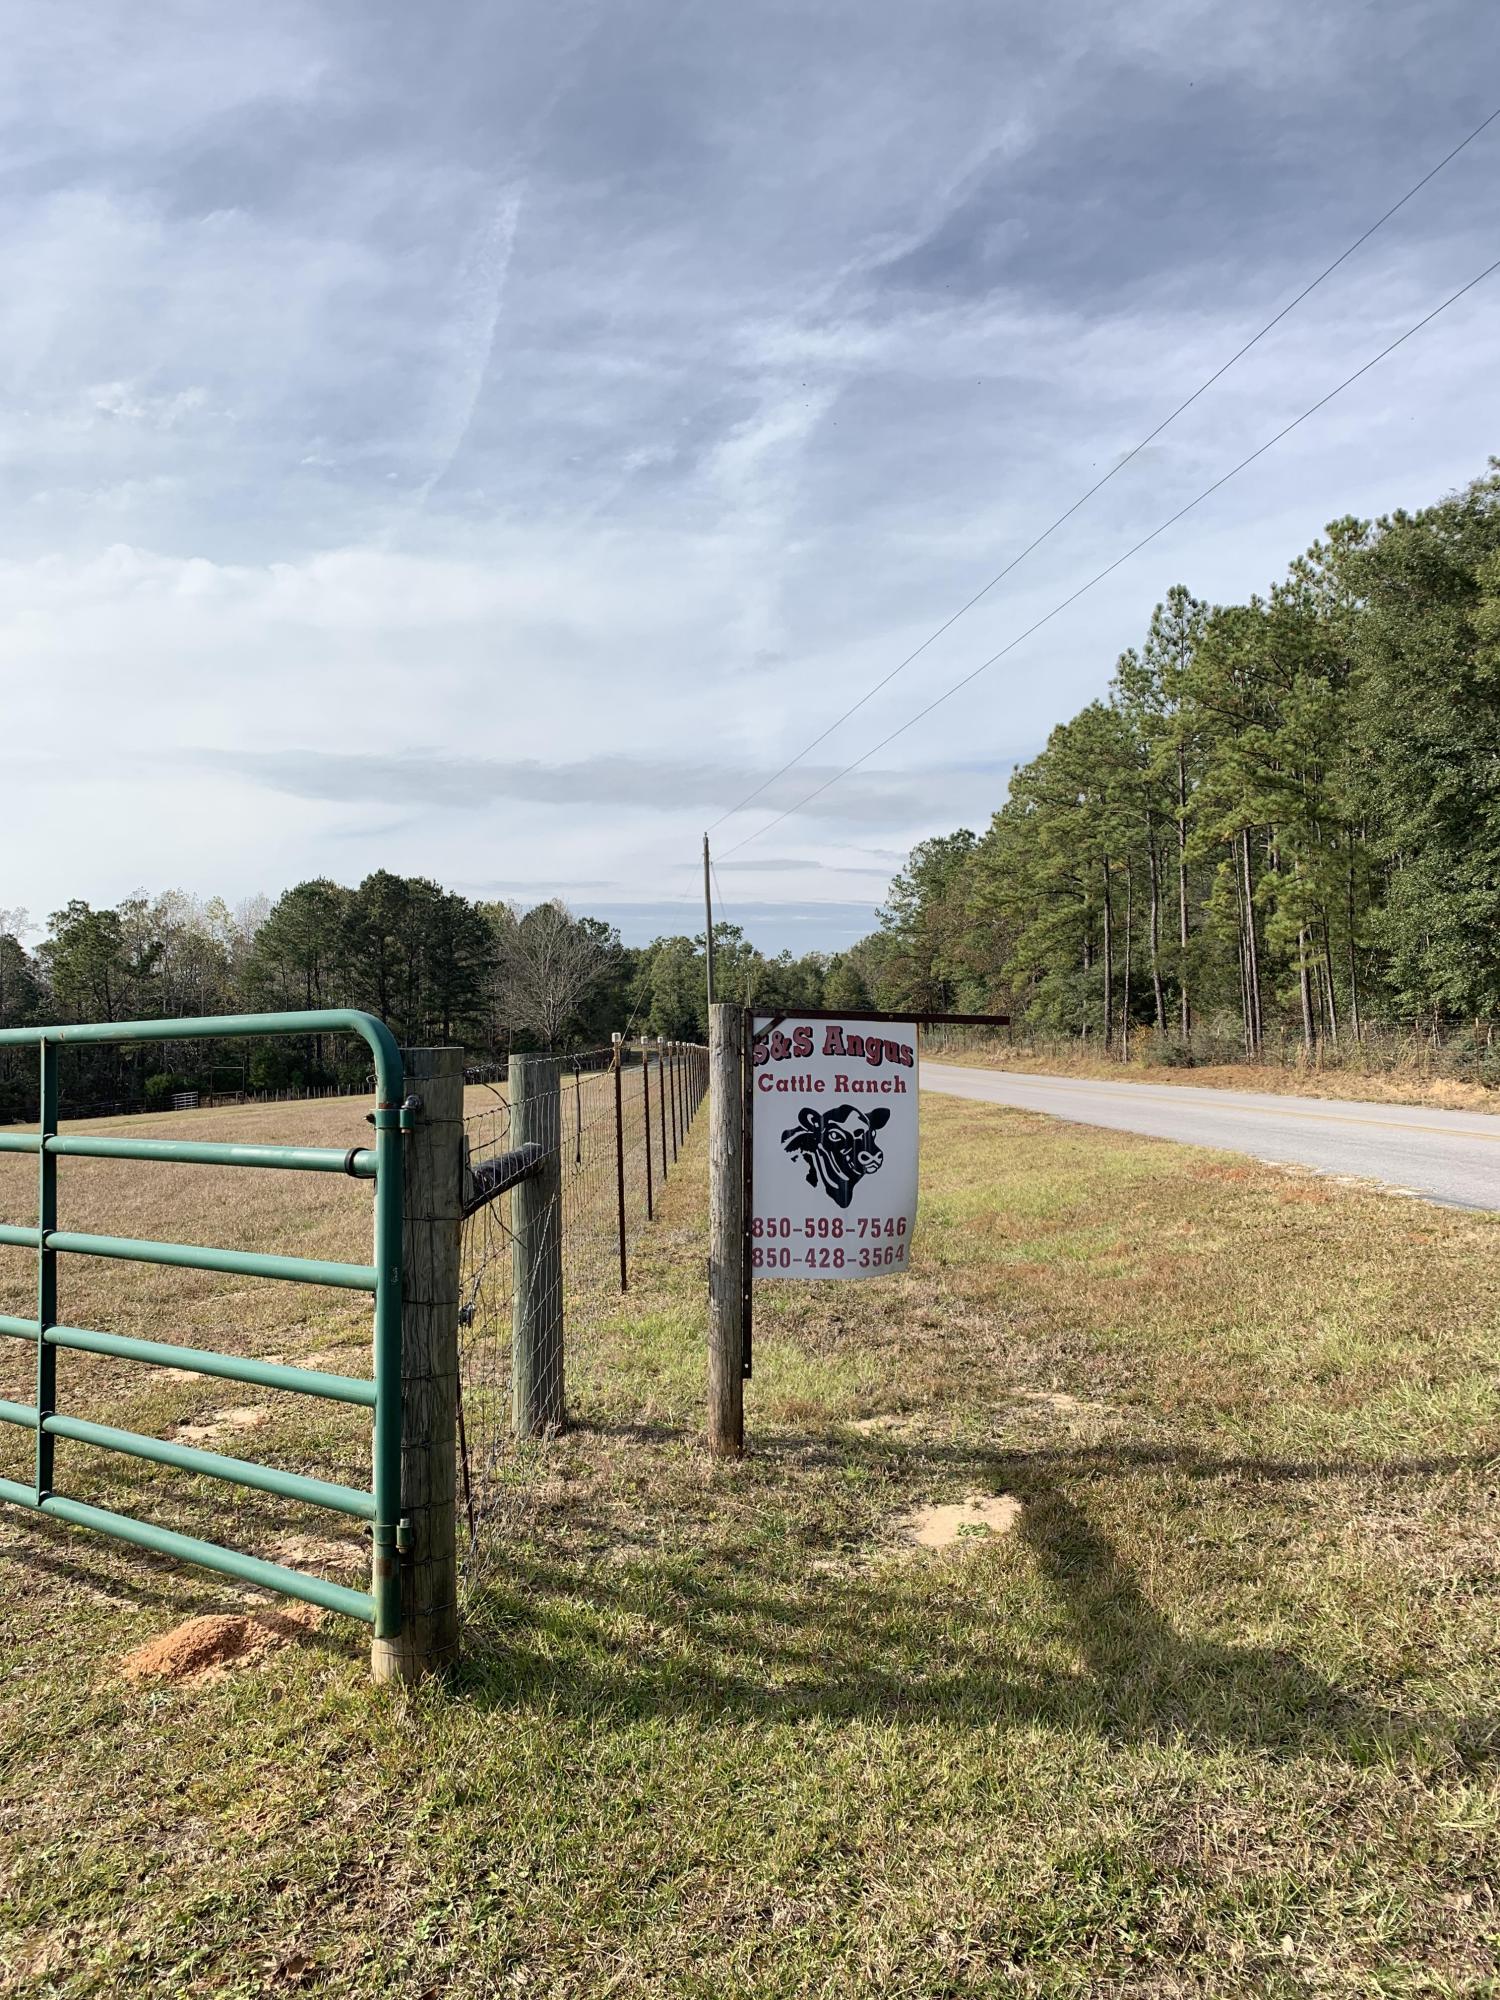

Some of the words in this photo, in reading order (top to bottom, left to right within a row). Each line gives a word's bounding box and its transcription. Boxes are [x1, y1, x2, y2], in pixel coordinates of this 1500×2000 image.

[822, 1025, 914, 1068] Angus
[758, 1073, 825, 1092] Cattle
[834, 1074, 907, 1093] Ranch
[752, 1216, 907, 1238] 850-598-7546
[752, 1244, 905, 1268] 850-428-3564
